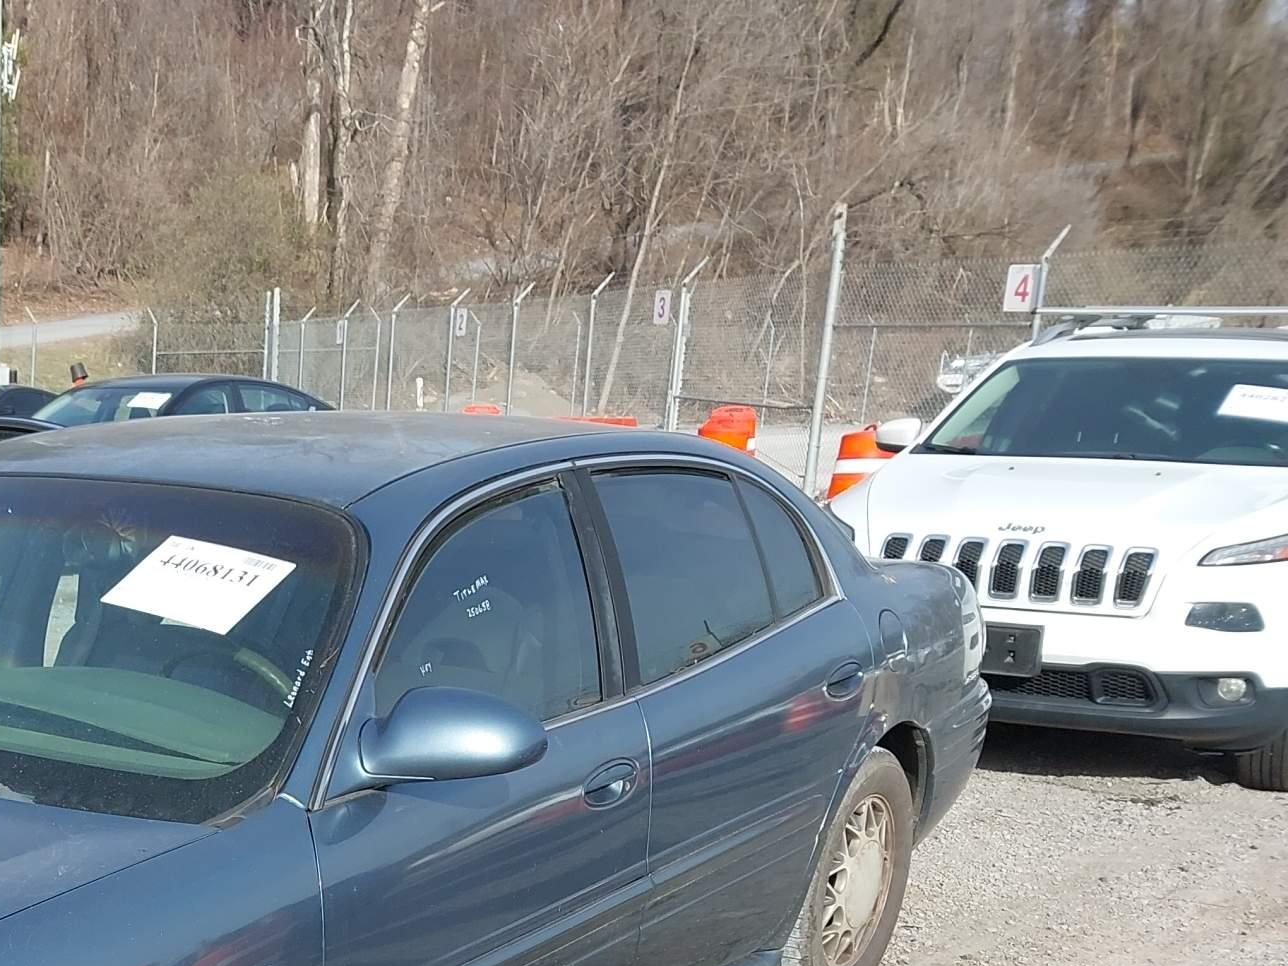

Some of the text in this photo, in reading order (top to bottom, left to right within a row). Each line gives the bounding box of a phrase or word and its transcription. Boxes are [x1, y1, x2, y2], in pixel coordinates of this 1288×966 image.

[1014, 274, 1030, 302] 4
[658, 296, 666, 319] 3
[458, 313, 465, 331] 2
[998, 522, 1045, 534] Jeep
[159, 554, 261, 587] 44068131
